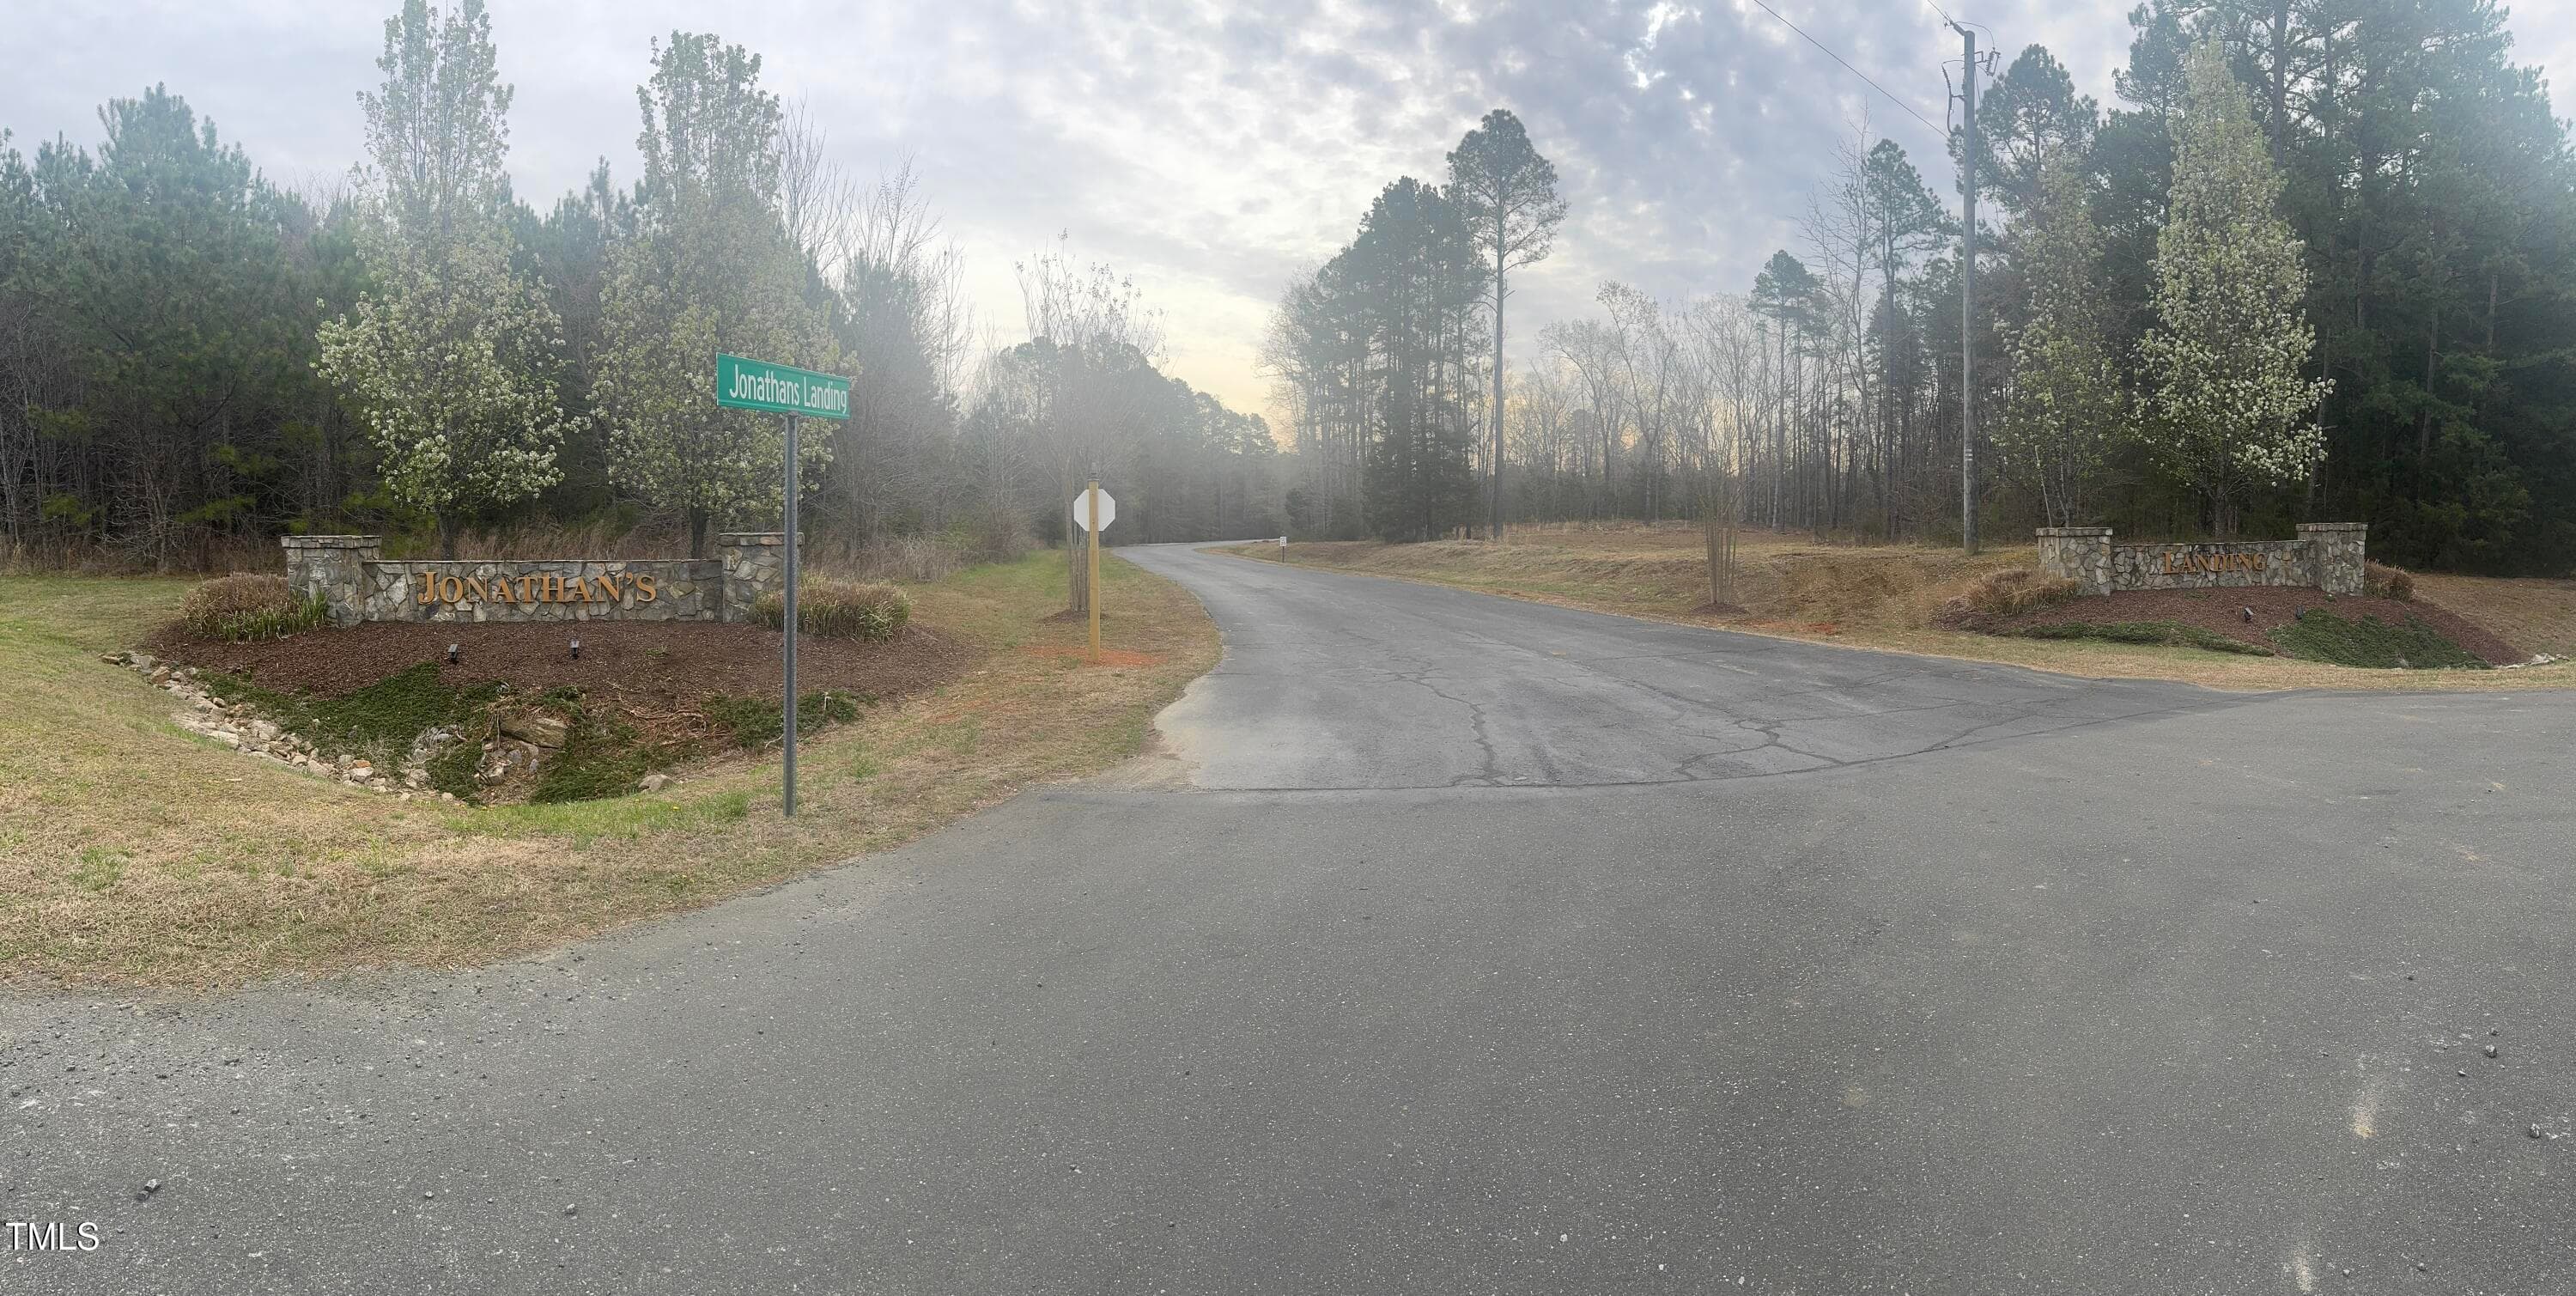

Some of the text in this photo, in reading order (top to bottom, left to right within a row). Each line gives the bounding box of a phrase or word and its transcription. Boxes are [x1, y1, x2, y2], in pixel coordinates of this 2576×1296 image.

[730, 364, 847, 414] Jonathans Landing
[417, 571, 658, 604] JONATHAN'S
